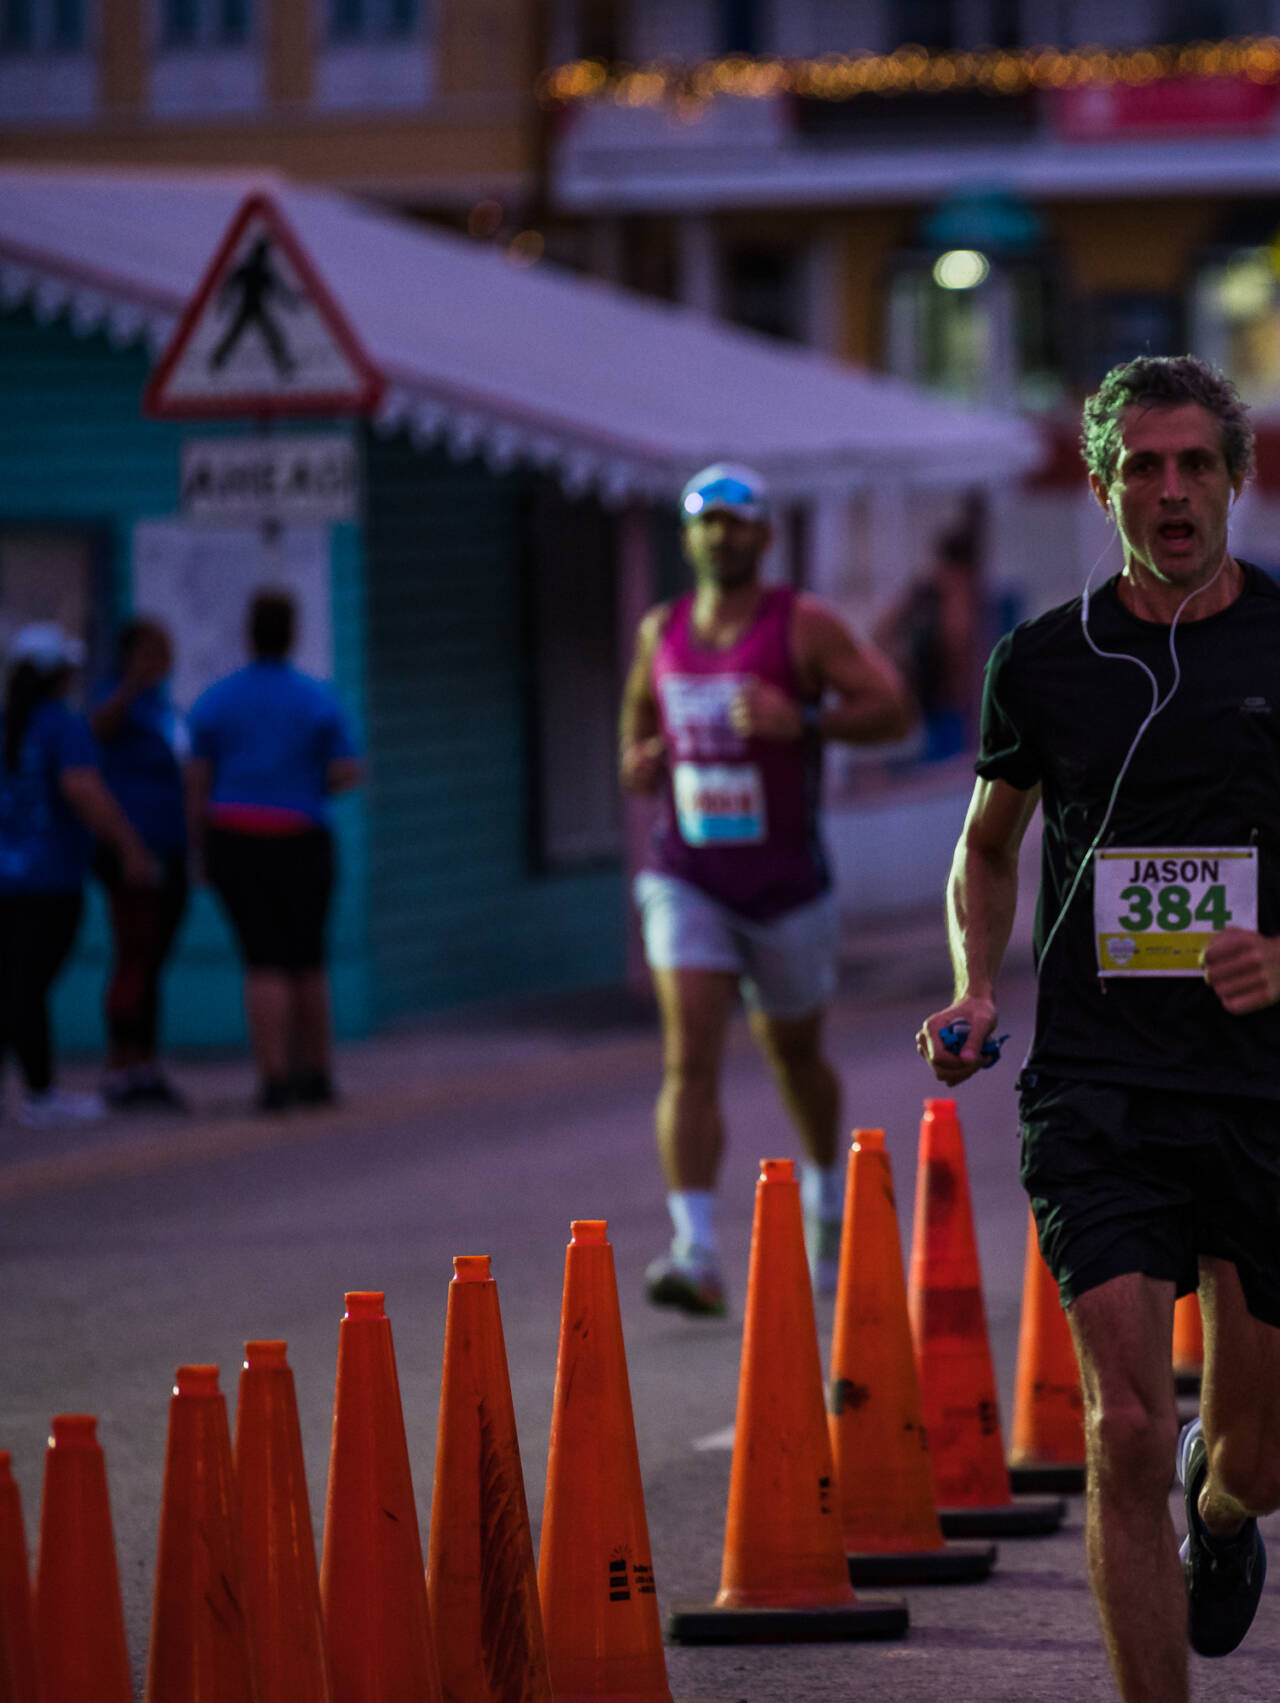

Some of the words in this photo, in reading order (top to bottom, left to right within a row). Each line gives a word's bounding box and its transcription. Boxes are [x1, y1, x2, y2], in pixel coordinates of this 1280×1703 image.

[186, 460, 355, 498] AHEAD
[1129, 860, 1219, 884] JASON
[1118, 884, 1233, 931] 384
